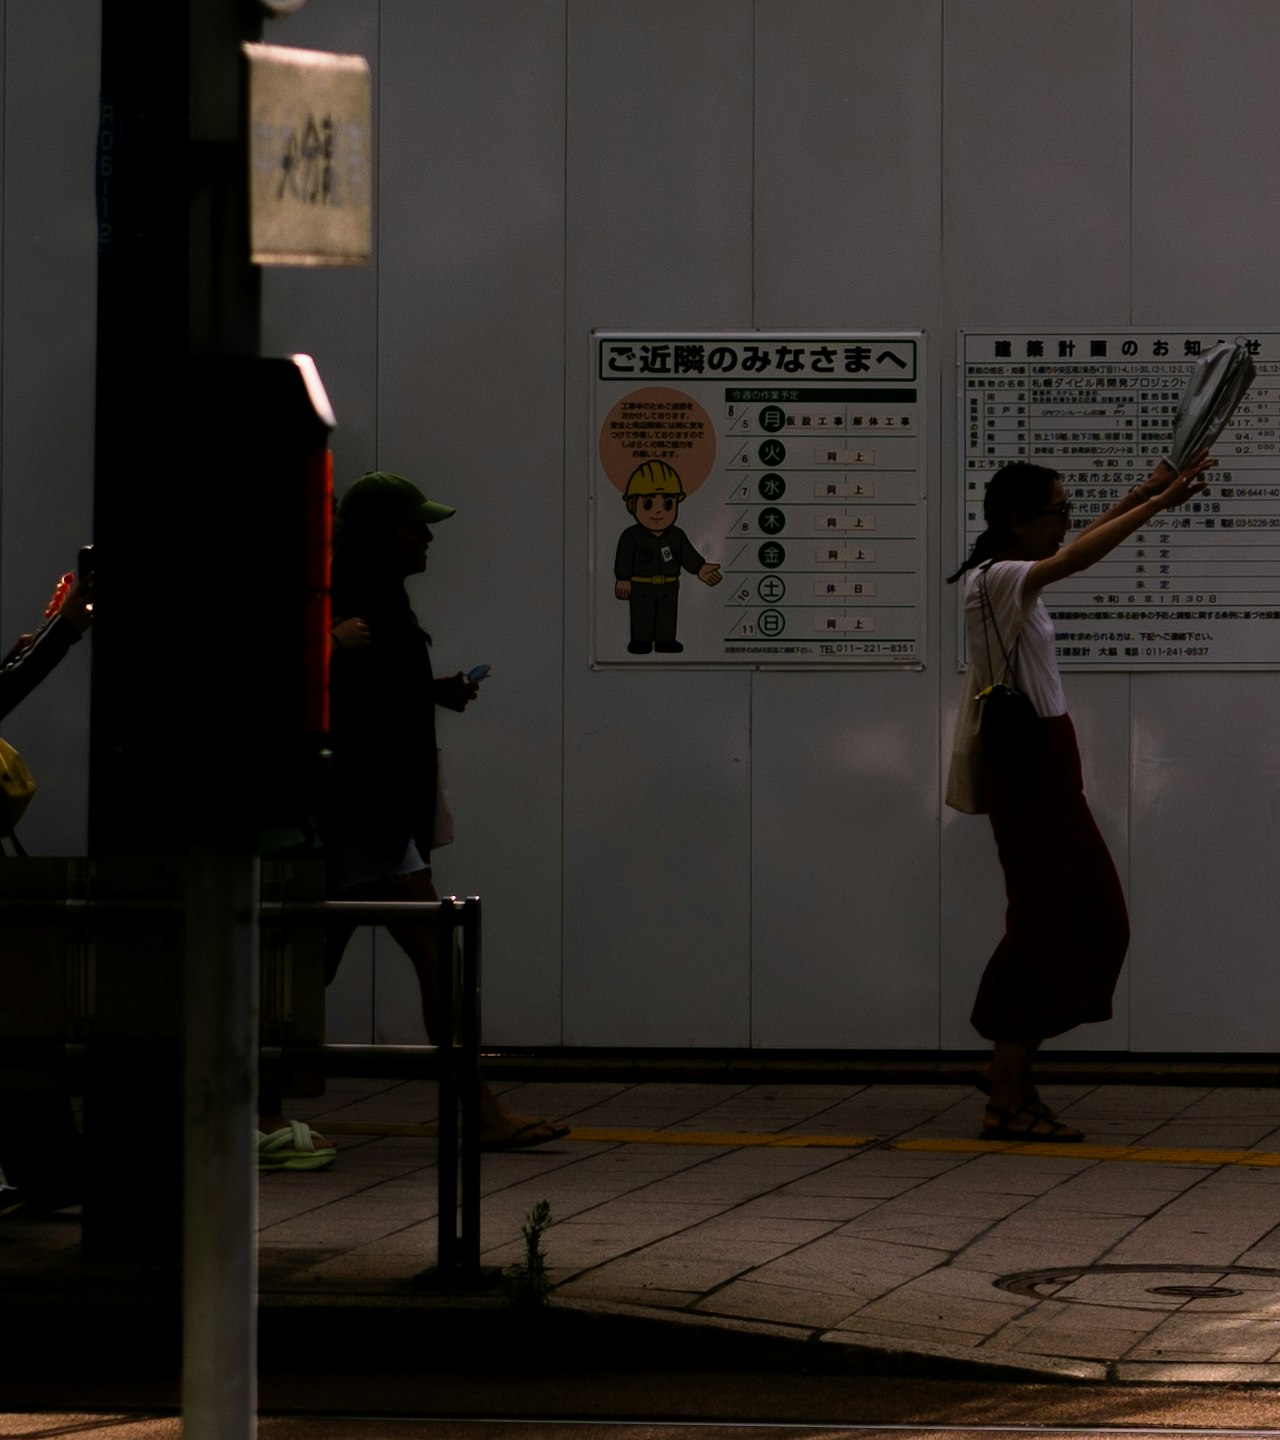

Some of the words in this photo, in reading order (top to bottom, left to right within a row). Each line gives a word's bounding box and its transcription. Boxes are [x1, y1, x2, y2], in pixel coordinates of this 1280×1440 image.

[994, 339, 1262, 359] 建築計画のお知せ
[608, 346, 908, 375] ご近隣のみなさまへ
[731, 389, 800, 401] 今週の作業予定
[742, 419, 748, 429] 5
[764, 411, 779, 428] 月
[742, 454, 748, 465] 6
[764, 445, 780, 462] 火
[742, 487, 748, 498] 7
[764, 478, 780, 496] 水
[764, 513, 780, 529] 木
[763, 546, 780, 564] 金
[738, 589, 750, 601] 10
[764, 581, 780, 597] 土
[742, 625, 754, 634] 11
[764, 616, 779, 631] 日
[820, 645, 836, 655] TEL
